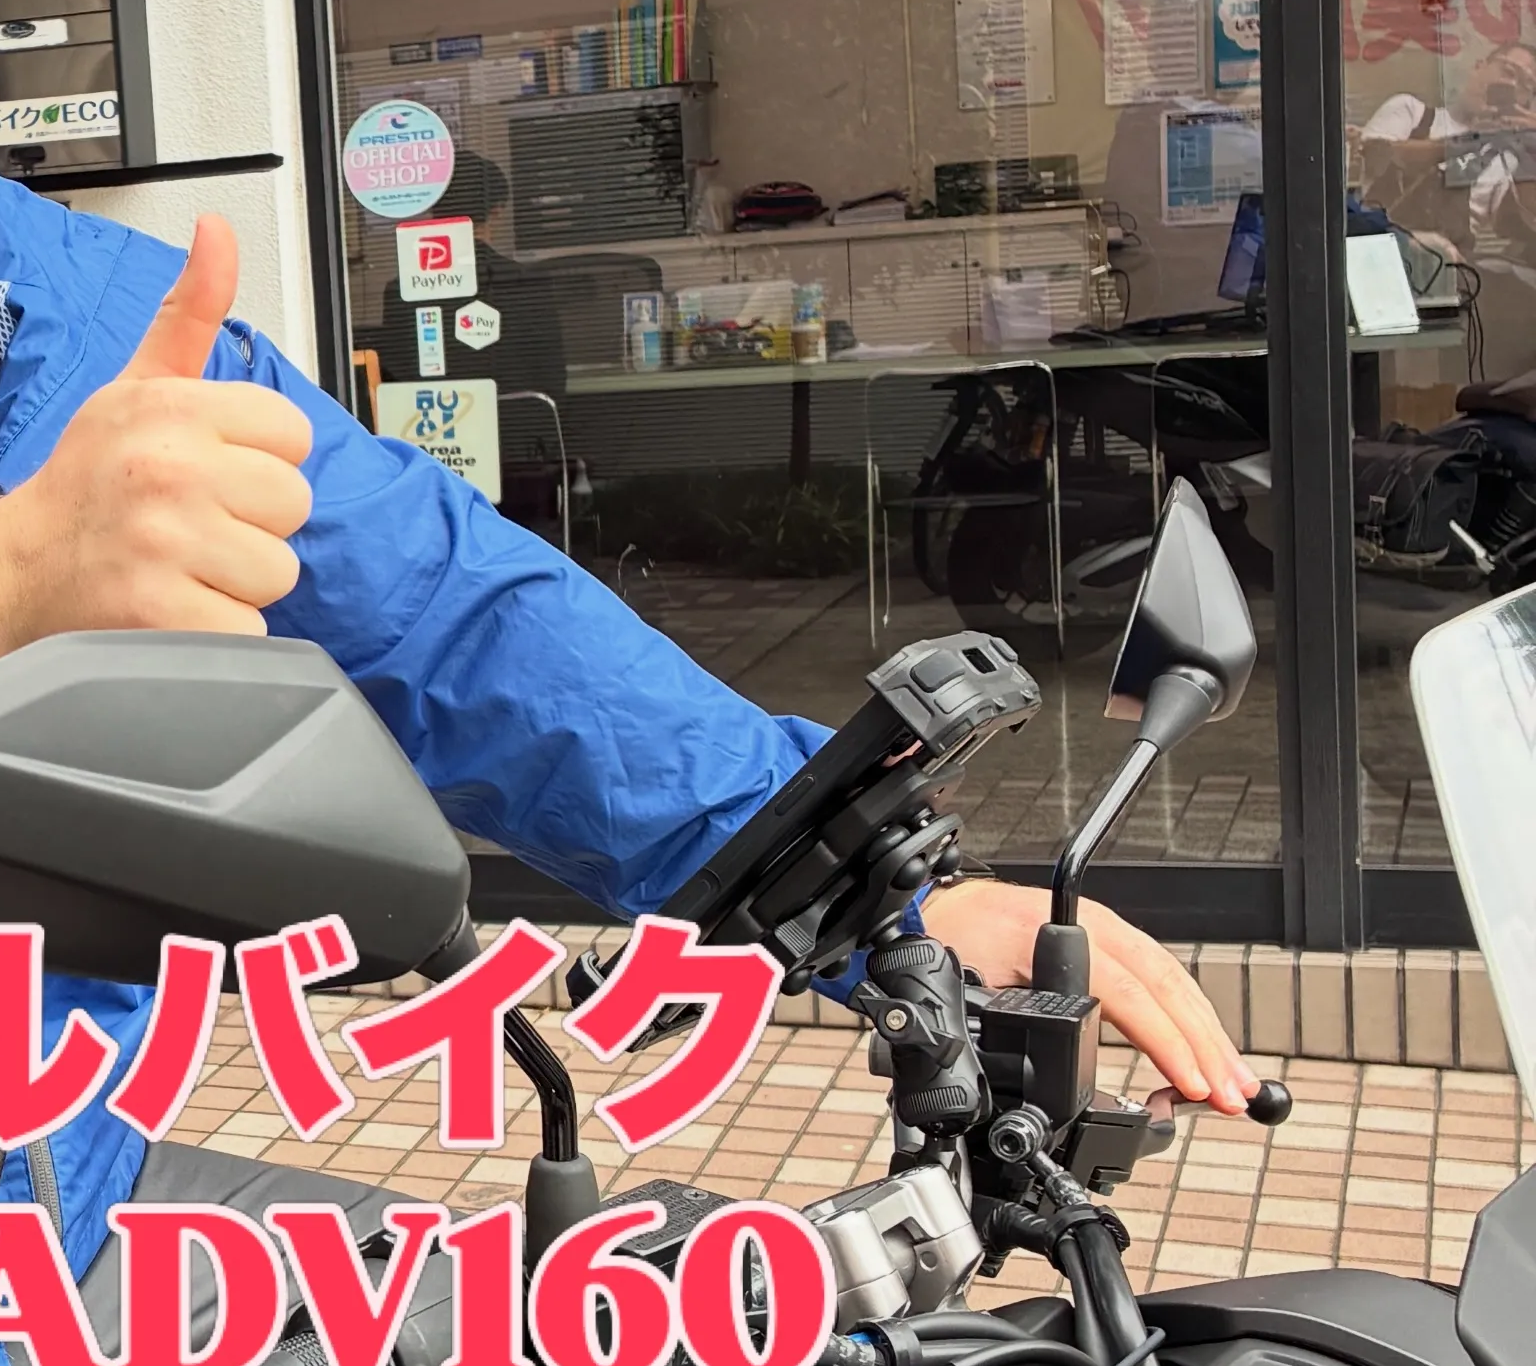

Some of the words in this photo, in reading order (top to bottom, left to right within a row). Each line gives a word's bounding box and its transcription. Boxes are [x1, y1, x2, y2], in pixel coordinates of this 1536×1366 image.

[62, 99, 120, 124] ECO
[359, 130, 435, 147] PRESTO
[350, 141, 447, 169] OFFICIAL
[368, 164, 431, 188] SHOP
[412, 272, 463, 290] PayPay
[476, 316, 495, 329] Pay
